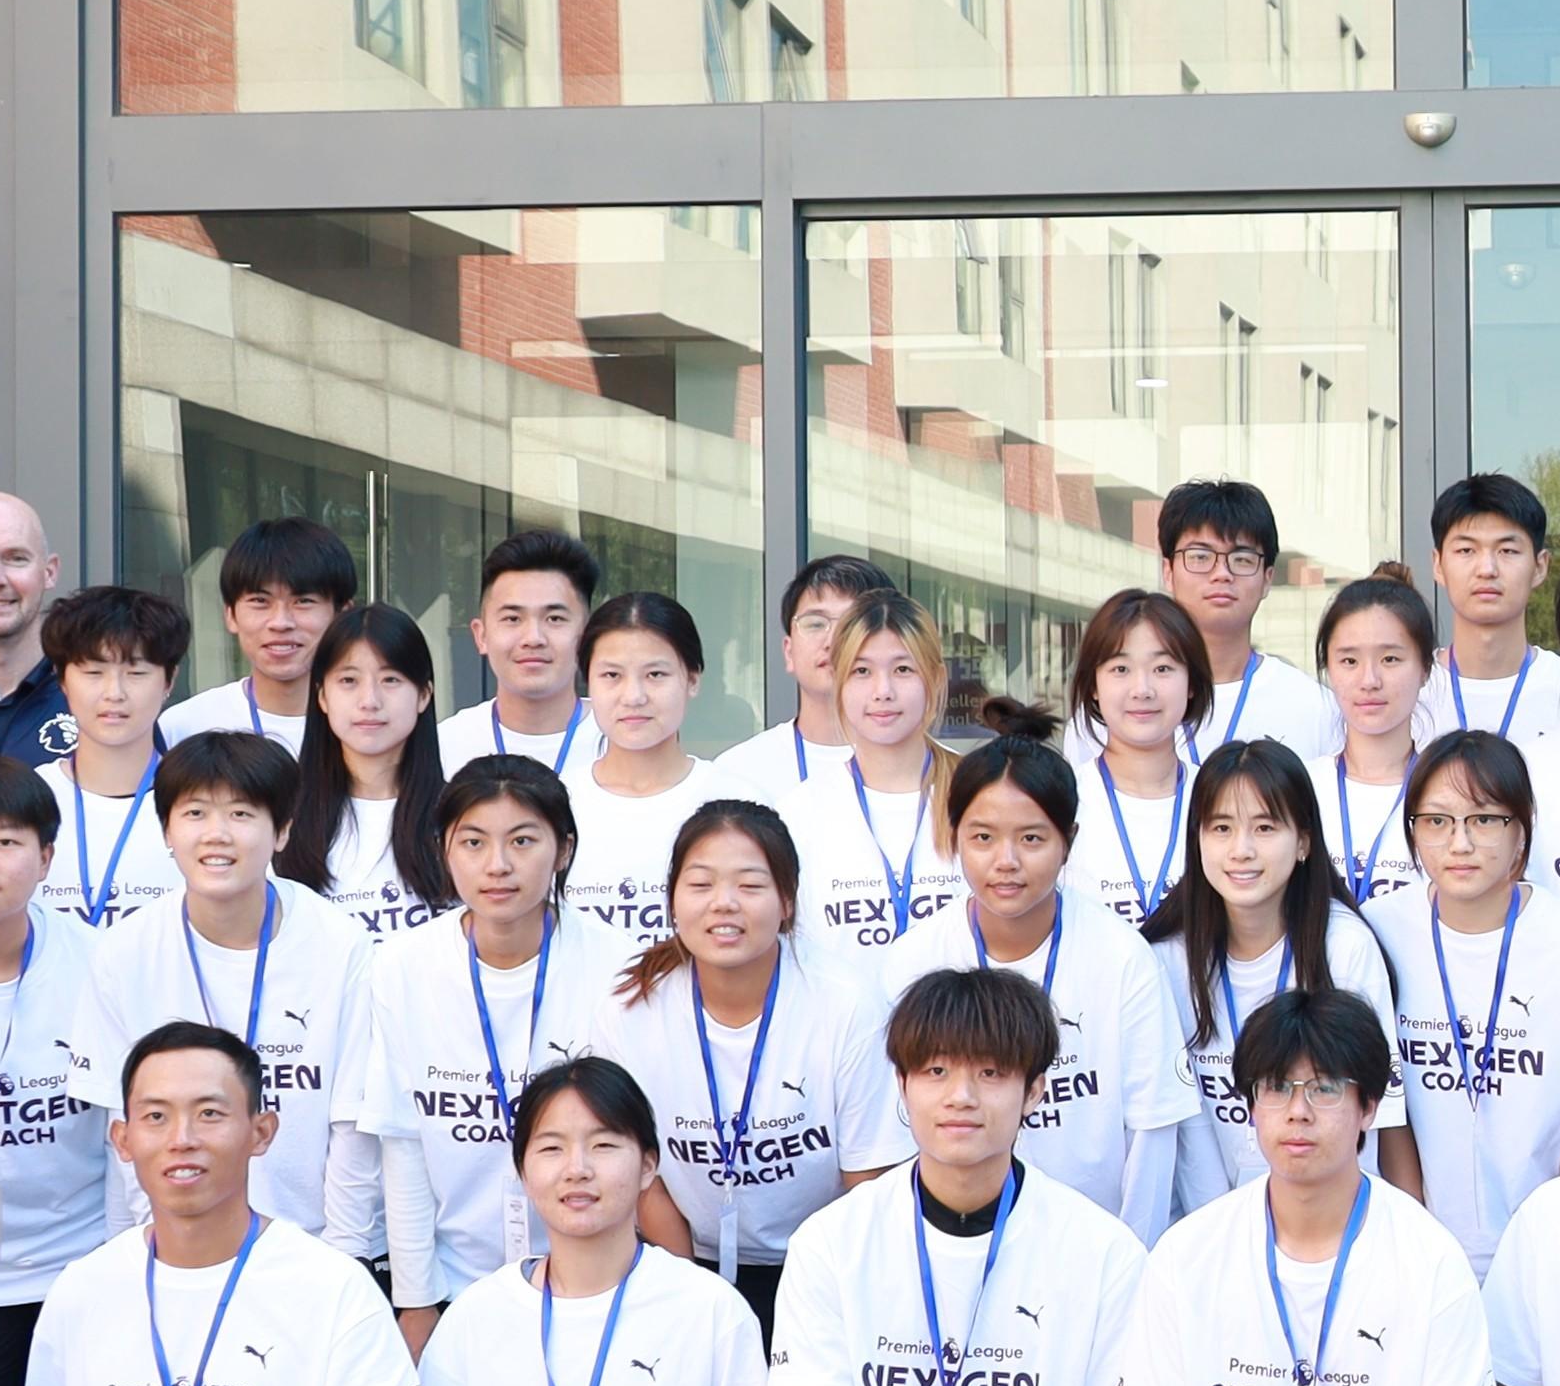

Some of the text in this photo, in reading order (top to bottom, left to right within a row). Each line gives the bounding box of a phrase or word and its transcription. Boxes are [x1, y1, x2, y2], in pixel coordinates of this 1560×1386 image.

[565, 881, 612, 899] Premier
[831, 877, 882, 892] Premier
[1399, 1015, 1450, 1032] Premier
[256, 1041, 303, 1057] eague
[20, 1072, 68, 1091] Leagu
[427, 1066, 480, 1084] Premier
[753, 1111, 805, 1132] League
[877, 1335, 934, 1357] Premie
[1228, 1357, 1287, 1379] Premier
